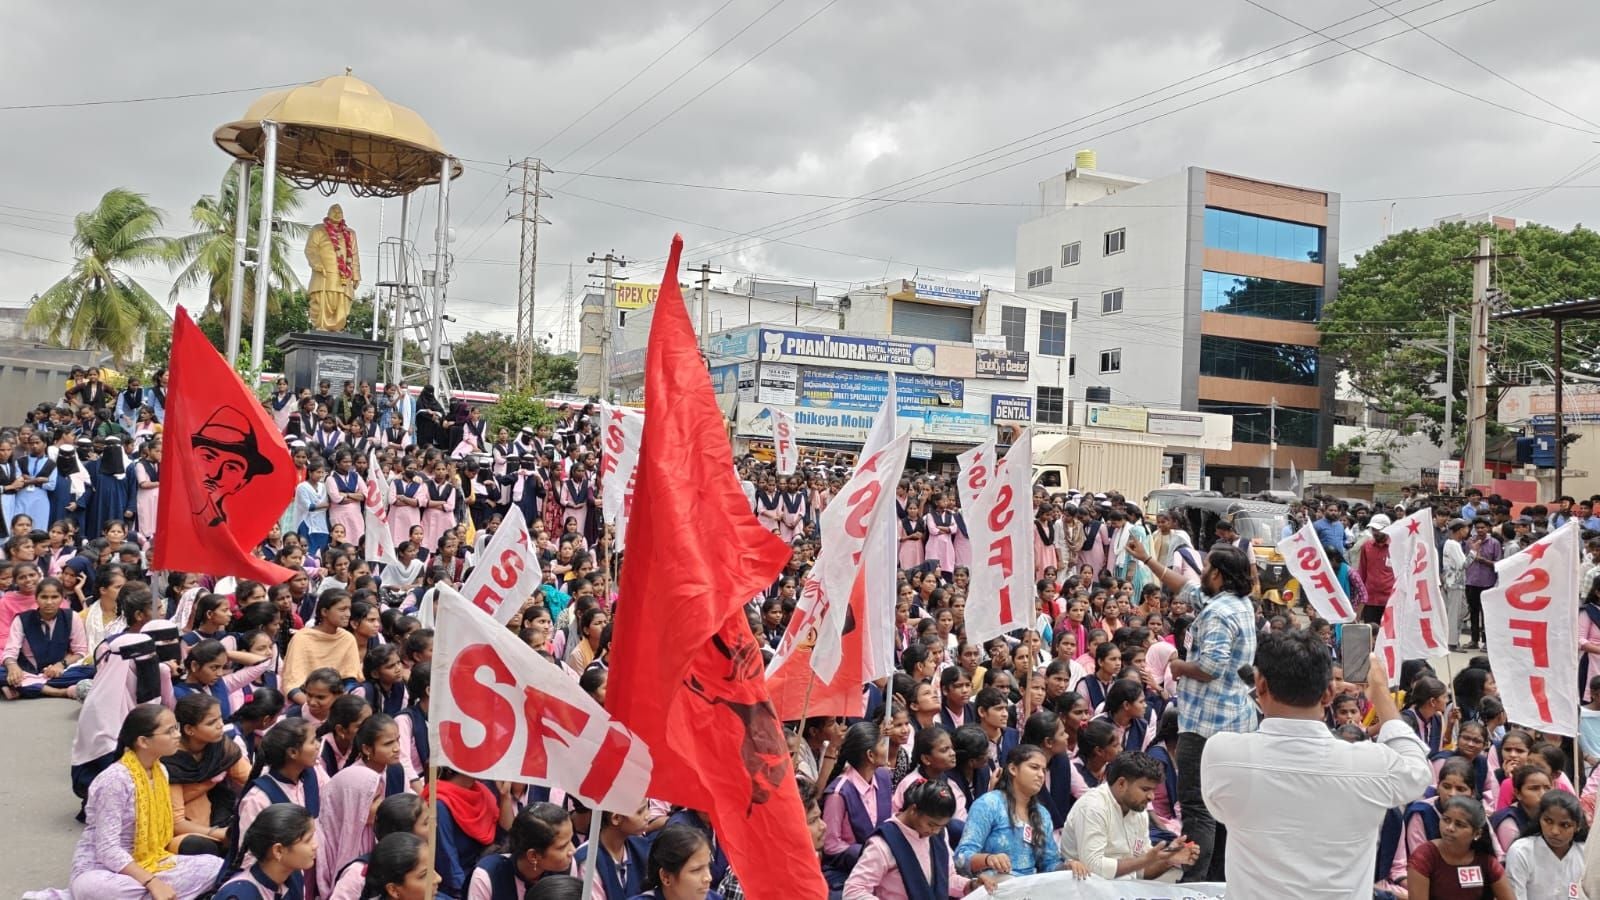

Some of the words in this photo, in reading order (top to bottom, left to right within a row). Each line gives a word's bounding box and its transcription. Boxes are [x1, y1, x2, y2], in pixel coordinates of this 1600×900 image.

[618, 286, 643, 303] APEX
[945, 286, 979, 296] CONSULTANT
[786, 335, 867, 361] PHANINDRA
[866, 344, 886, 354] DENTAL
[887, 346, 912, 357] HOSPITAL
[867, 353, 890, 362] IMPLANT
[891, 355, 911, 364] CENTER
[850, 394, 878, 403] SPECIALITY
[795, 411, 838, 427] thikeya
[841, 414, 873, 429] Mobil
[996, 405, 1030, 420] DENTAL
[600, 424, 625, 479] SF
[777, 422, 790, 472] SFI
[473, 549, 525, 616] SF
[439, 643, 632, 806] SFI
[1460, 866, 1481, 883] SFI
